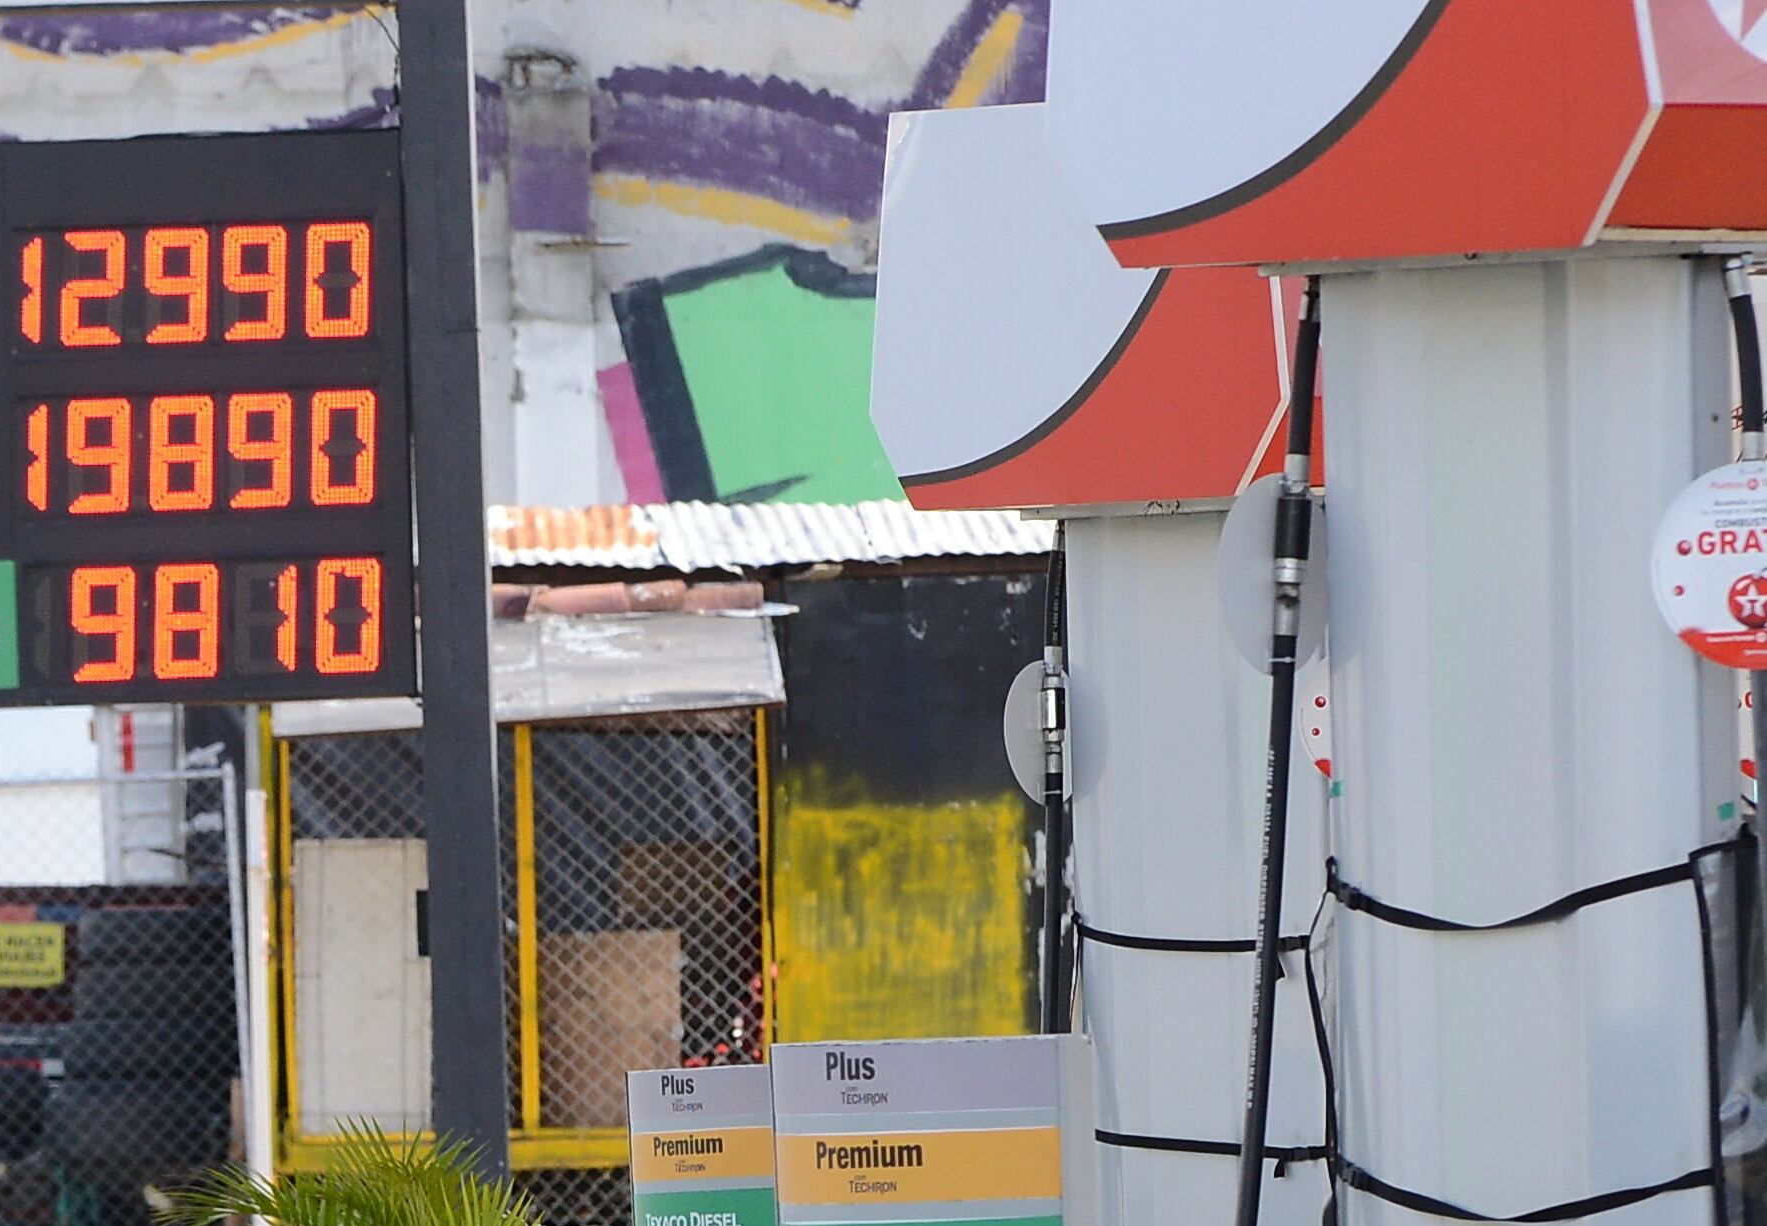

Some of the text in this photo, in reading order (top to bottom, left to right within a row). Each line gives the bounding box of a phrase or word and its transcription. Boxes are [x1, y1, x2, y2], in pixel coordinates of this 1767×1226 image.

[21, 222, 370, 346] 12990
[27, 390, 375, 514] 19890
[1697, 529, 1767, 556] GRA
[71, 558, 380, 682] 9810
[826, 1051, 876, 1081] Plus
[661, 1074, 695, 1097] Plus
[840, 1091, 889, 1106] TECHRON
[653, 1134, 724, 1157] Premium
[816, 1139, 924, 1169] Premium
[848, 1180, 898, 1195] TECHRON
